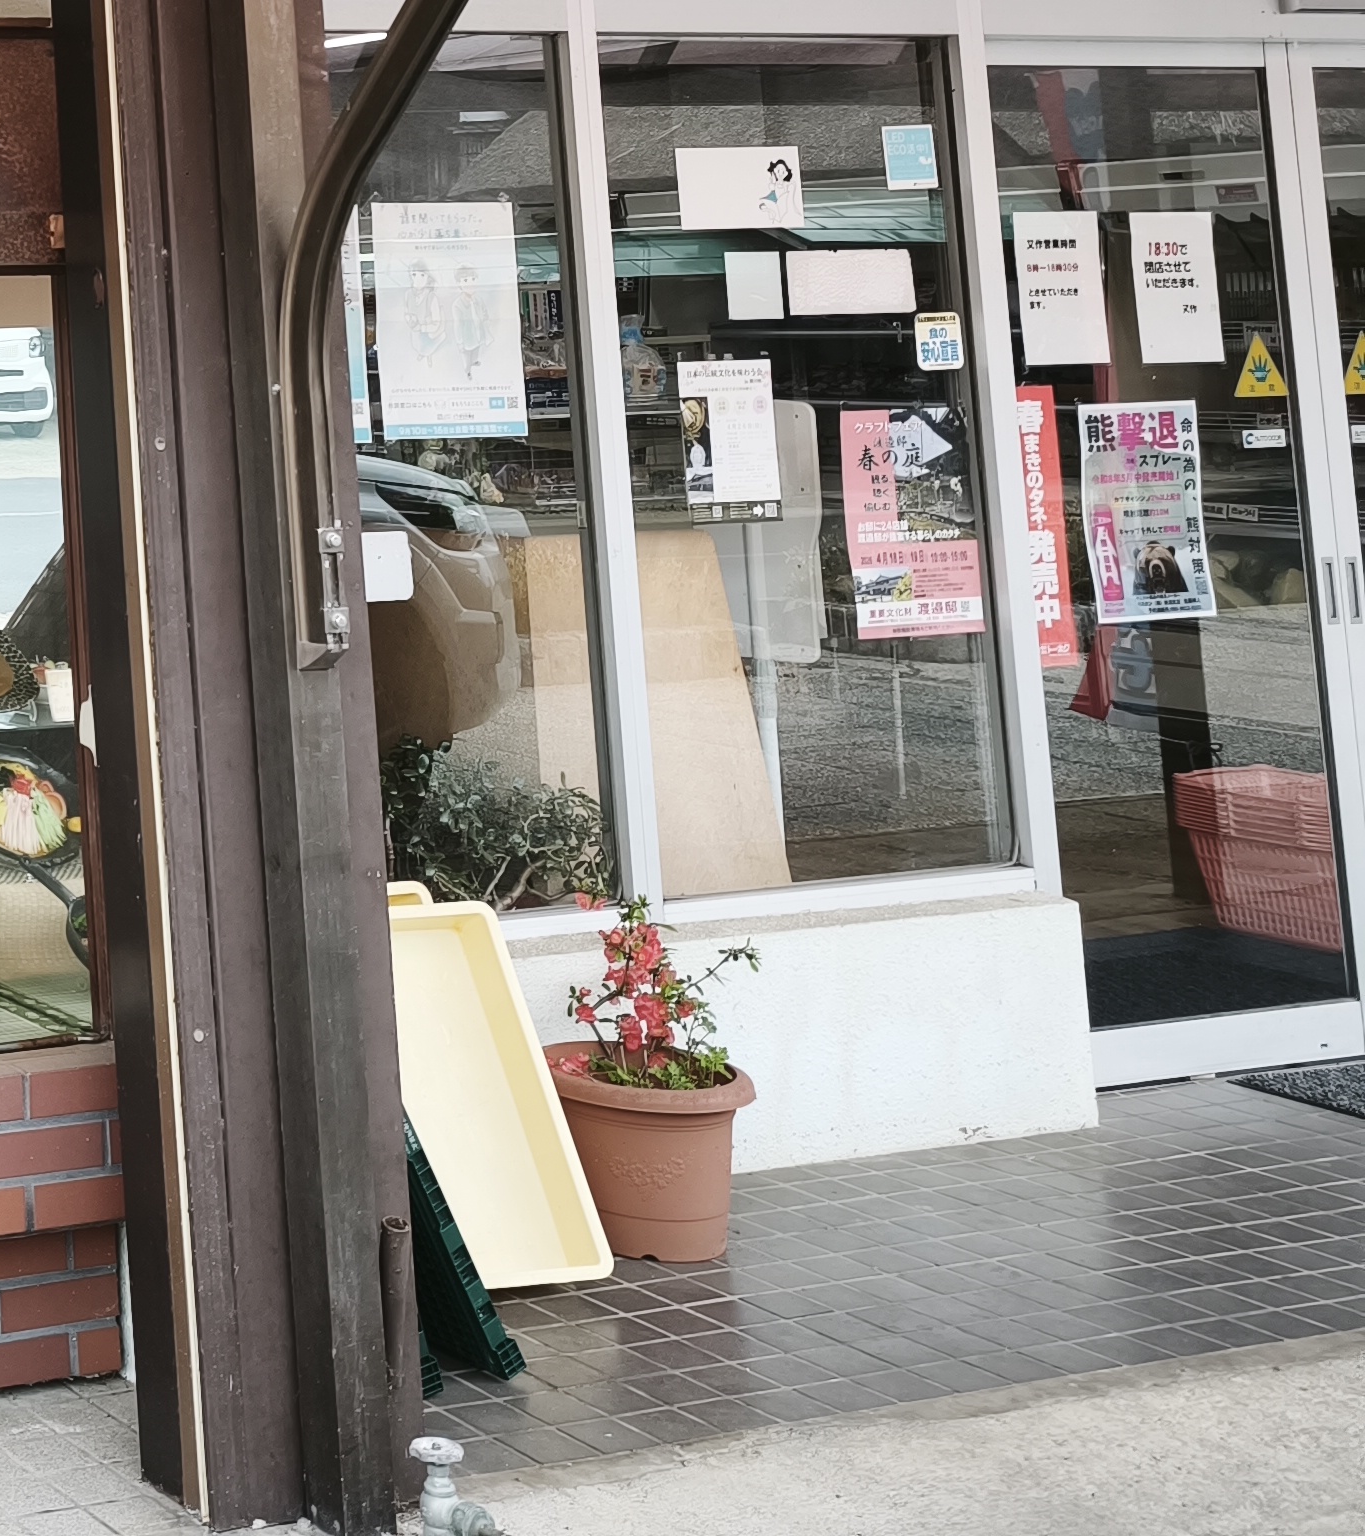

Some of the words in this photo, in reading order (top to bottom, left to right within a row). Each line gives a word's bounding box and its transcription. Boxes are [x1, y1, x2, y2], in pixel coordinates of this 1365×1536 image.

[1026, 239, 1077, 249] 又作営業時間
[1148, 242, 1188, 256] 18:30で
[1144, 261, 1192, 274] 閉店させて
[1145, 277, 1200, 289] いただきます。
[1028, 288, 1079, 297] とさせていただき
[1029, 301, 1046, 310] ます。
[1182, 304, 1198, 314] 又作
[920, 340, 959, 362] 安心宣言
[854, 421, 923, 435] クラフトフェア
[1084, 410, 1179, 453] 熊撃退
[857, 443, 925, 472] 春の庭
[1139, 452, 1181, 468] スプレー
[869, 607, 912, 620] 重要文化財
